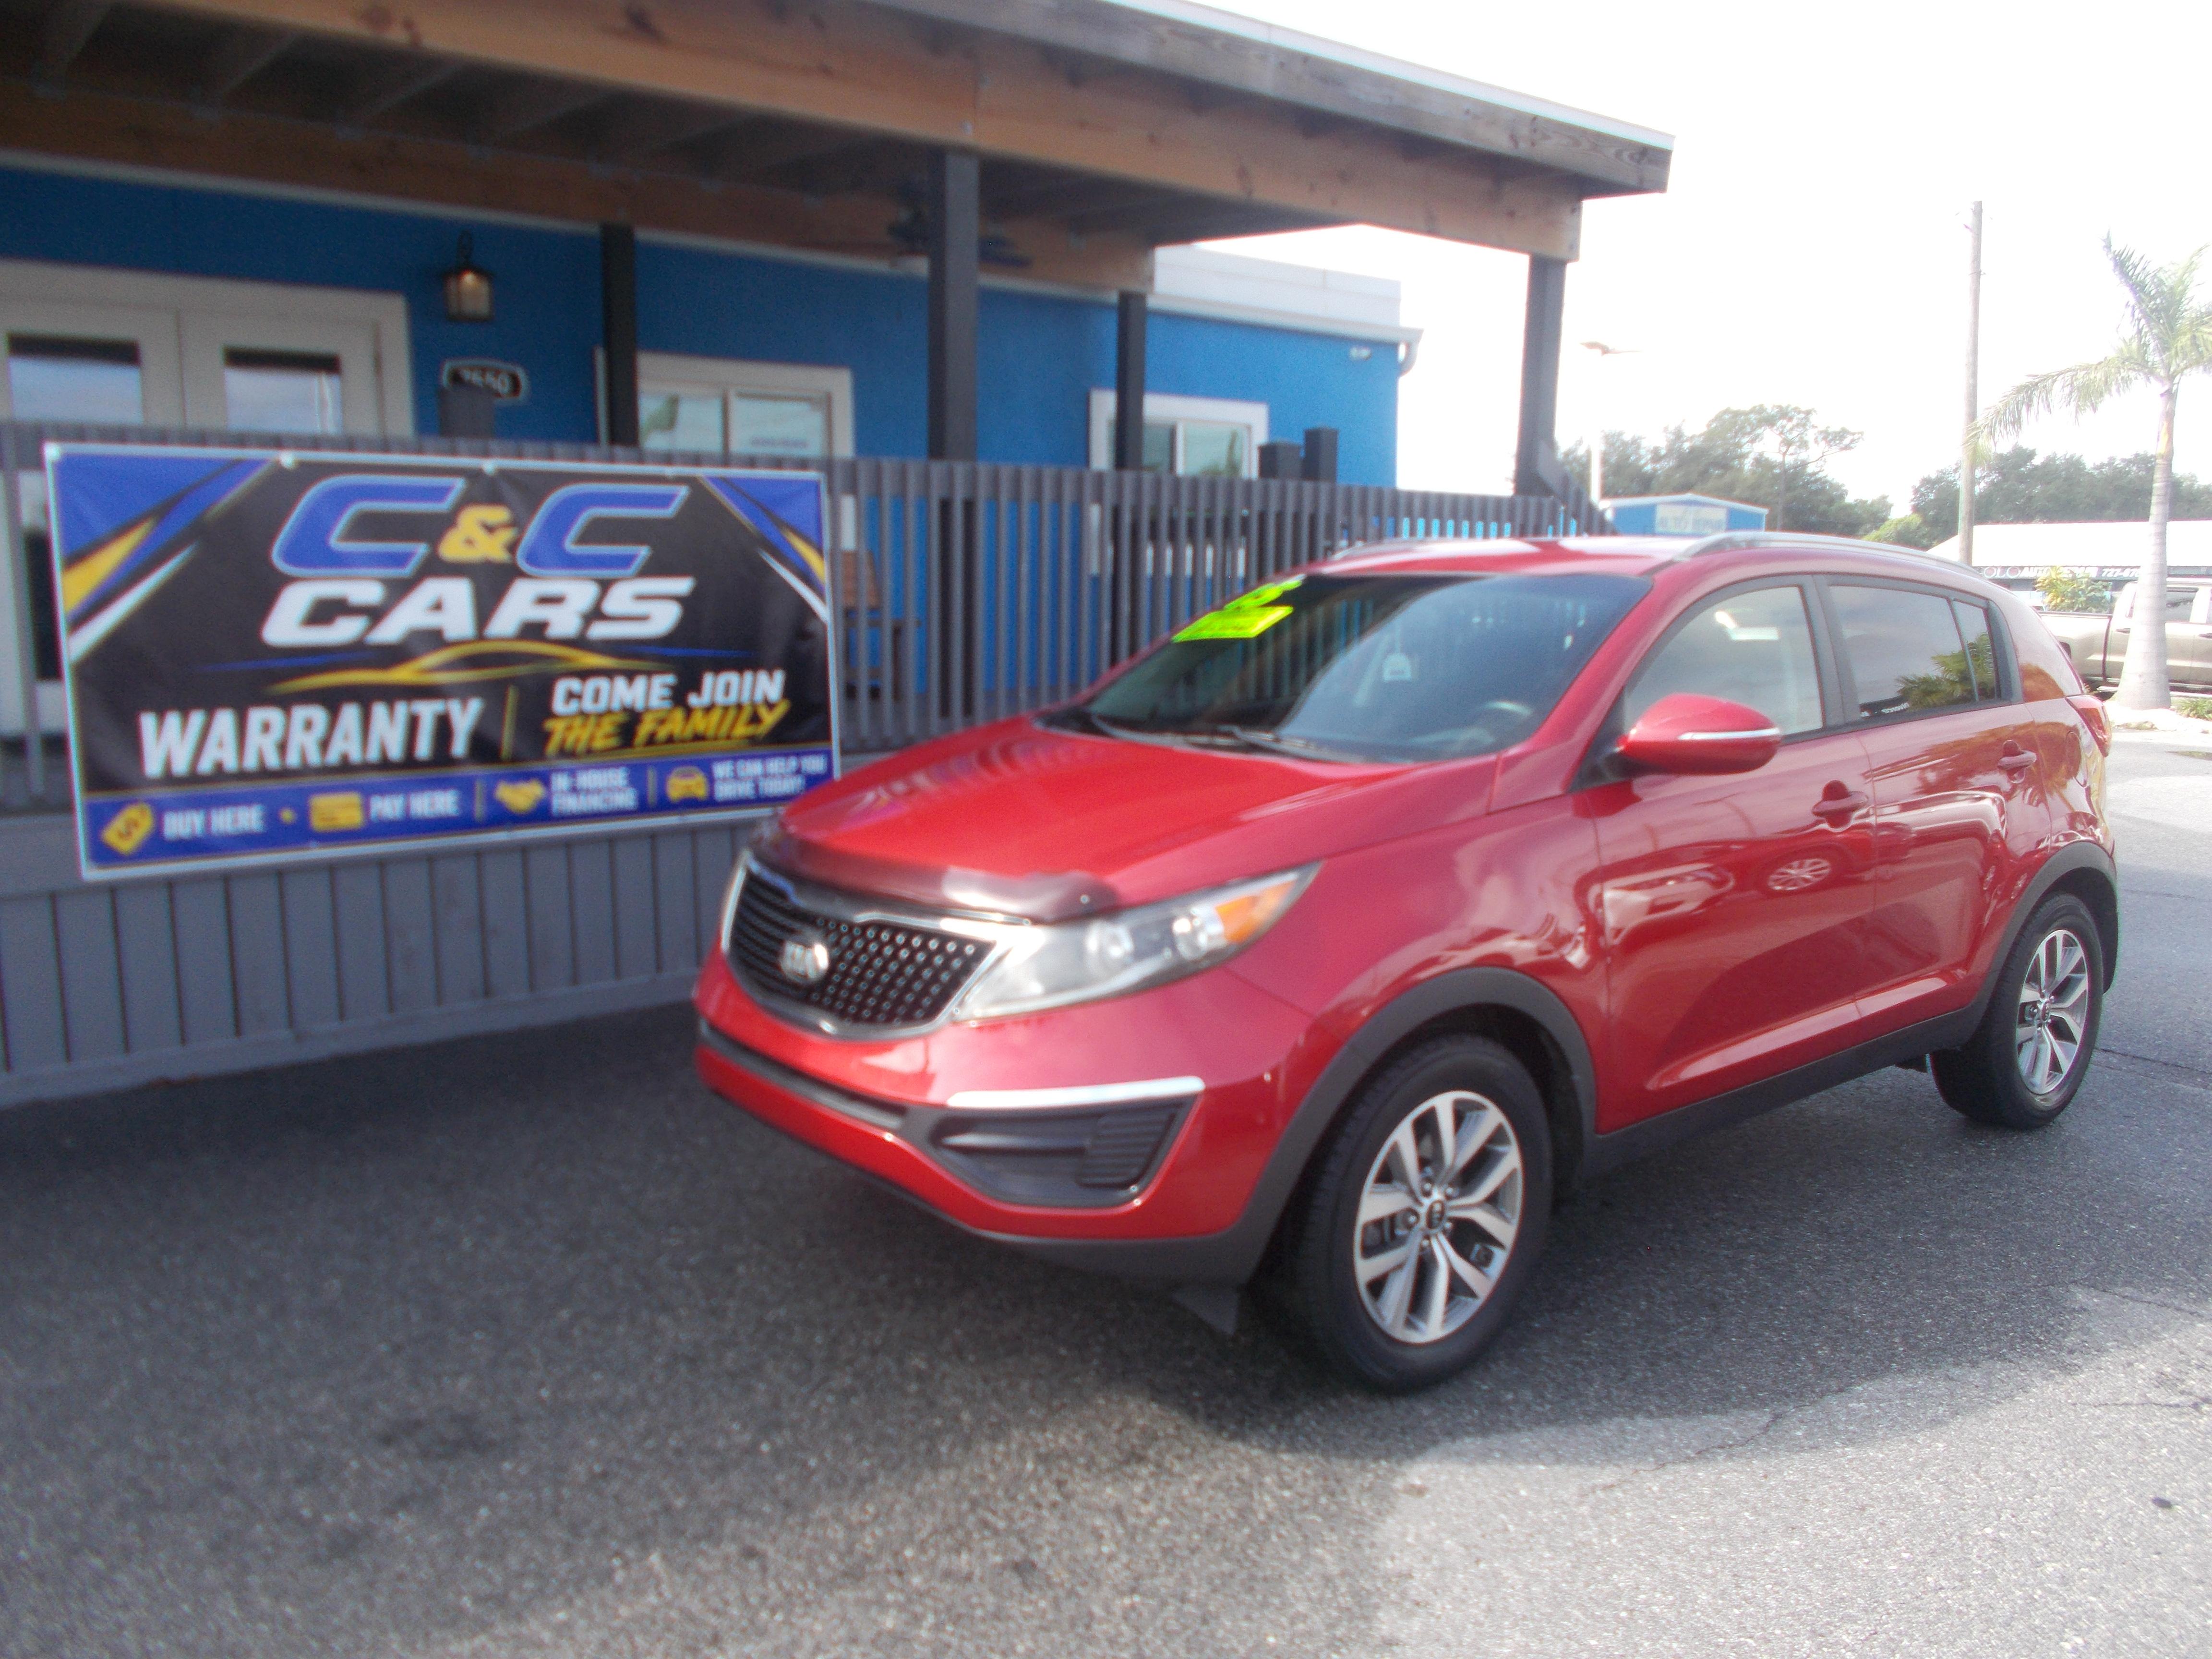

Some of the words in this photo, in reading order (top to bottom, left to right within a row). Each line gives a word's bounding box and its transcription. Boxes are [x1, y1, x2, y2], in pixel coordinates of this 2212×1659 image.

[271, 473, 690, 578] C&C
[260, 576, 696, 647] CARS
[550, 673, 678, 716] COME
[686, 670, 787, 708] JOIN
[139, 696, 484, 779] WARRANTY
[543, 712, 630, 757] THE
[633, 698, 792, 748] FAMILY
[162, 809, 206, 841] BUY
[207, 803, 267, 835] HERE
[370, 793, 406, 821] PAY
[408, 789, 461, 817] HERE
